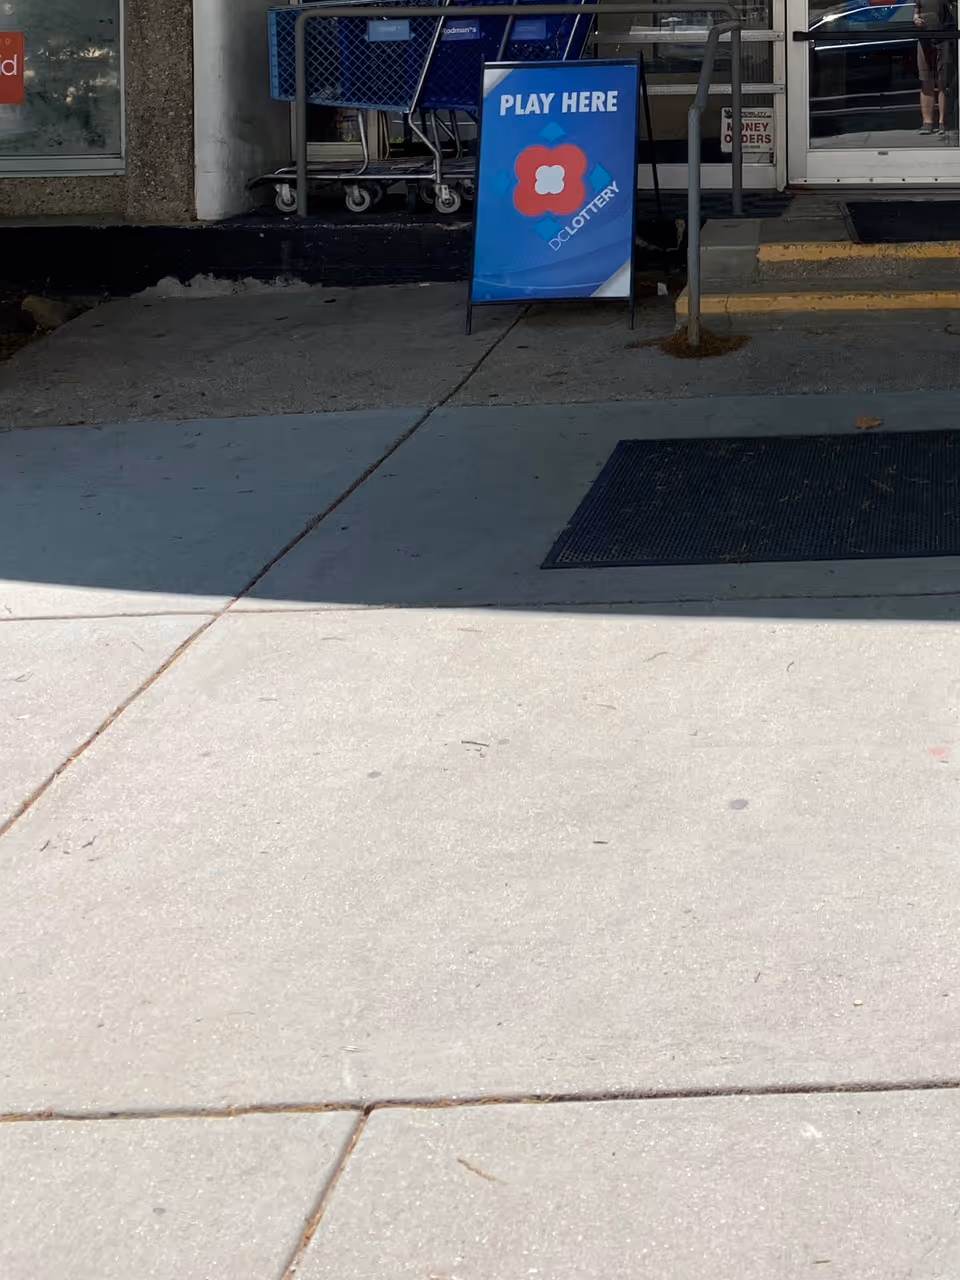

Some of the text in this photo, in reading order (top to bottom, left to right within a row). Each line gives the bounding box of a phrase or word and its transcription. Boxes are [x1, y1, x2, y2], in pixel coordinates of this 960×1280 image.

[499, 90, 618, 116] PLAY HERE
[724, 134, 772, 144] ODERS
